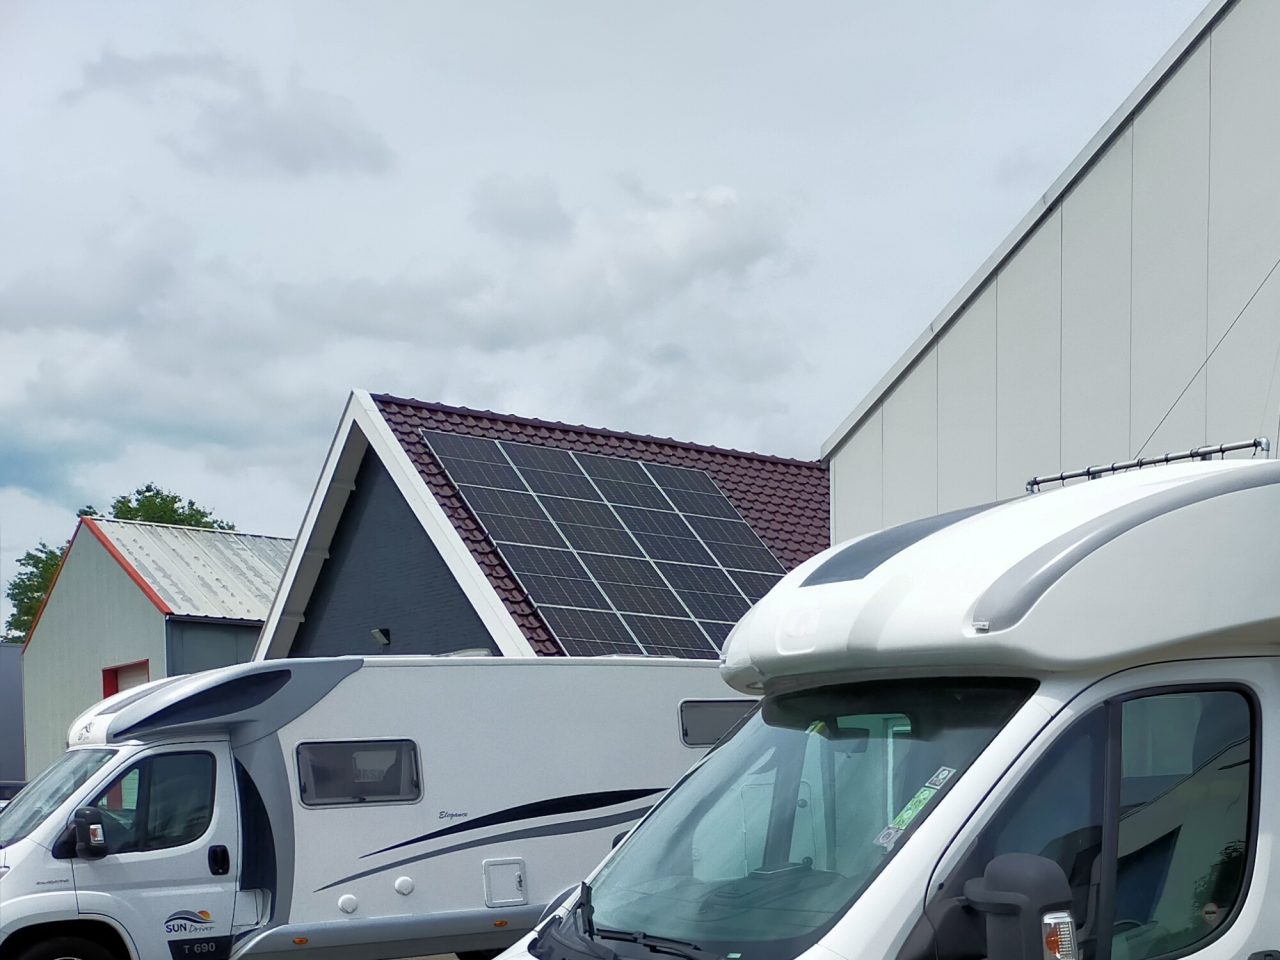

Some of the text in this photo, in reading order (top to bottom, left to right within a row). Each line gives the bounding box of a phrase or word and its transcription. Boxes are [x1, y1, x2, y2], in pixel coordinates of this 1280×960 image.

[165, 923, 187, 933] SUN
[183, 942, 216, 954] T 690
